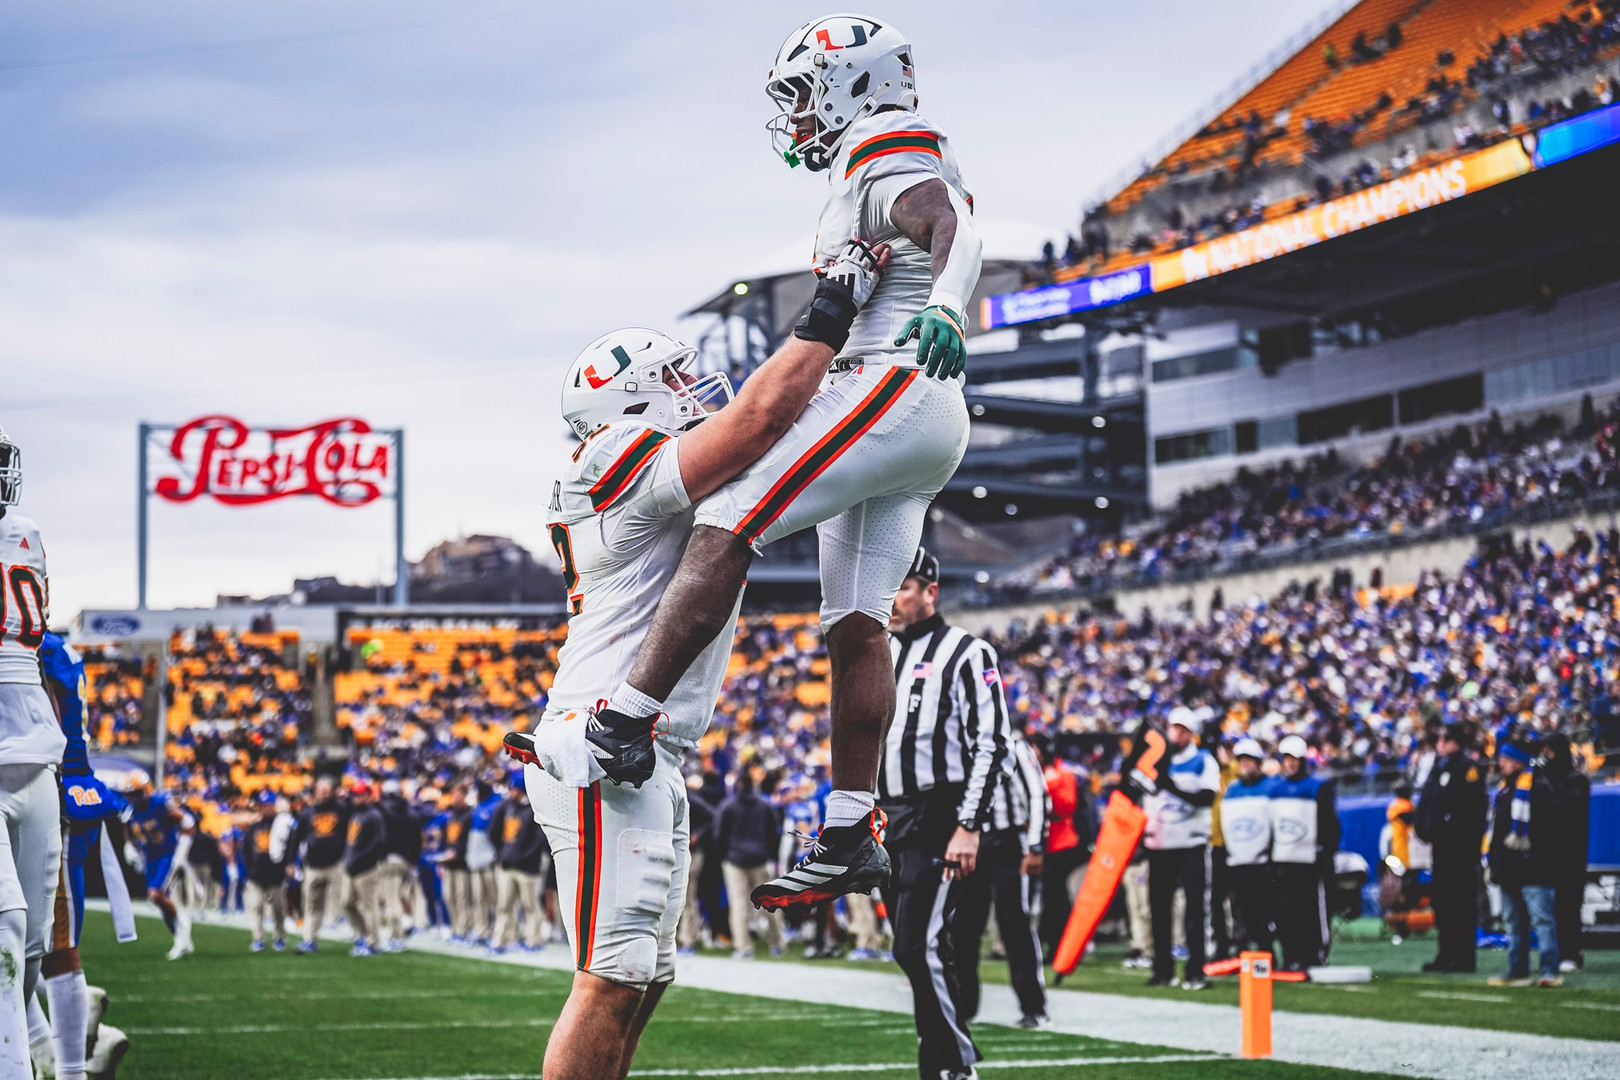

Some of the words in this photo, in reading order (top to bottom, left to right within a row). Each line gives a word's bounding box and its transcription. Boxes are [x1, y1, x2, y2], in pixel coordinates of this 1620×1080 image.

[1208, 209, 1322, 276] NATIONAL
[1322, 160, 1467, 239] CHAMPIONS
[908, 693, 922, 713] F
